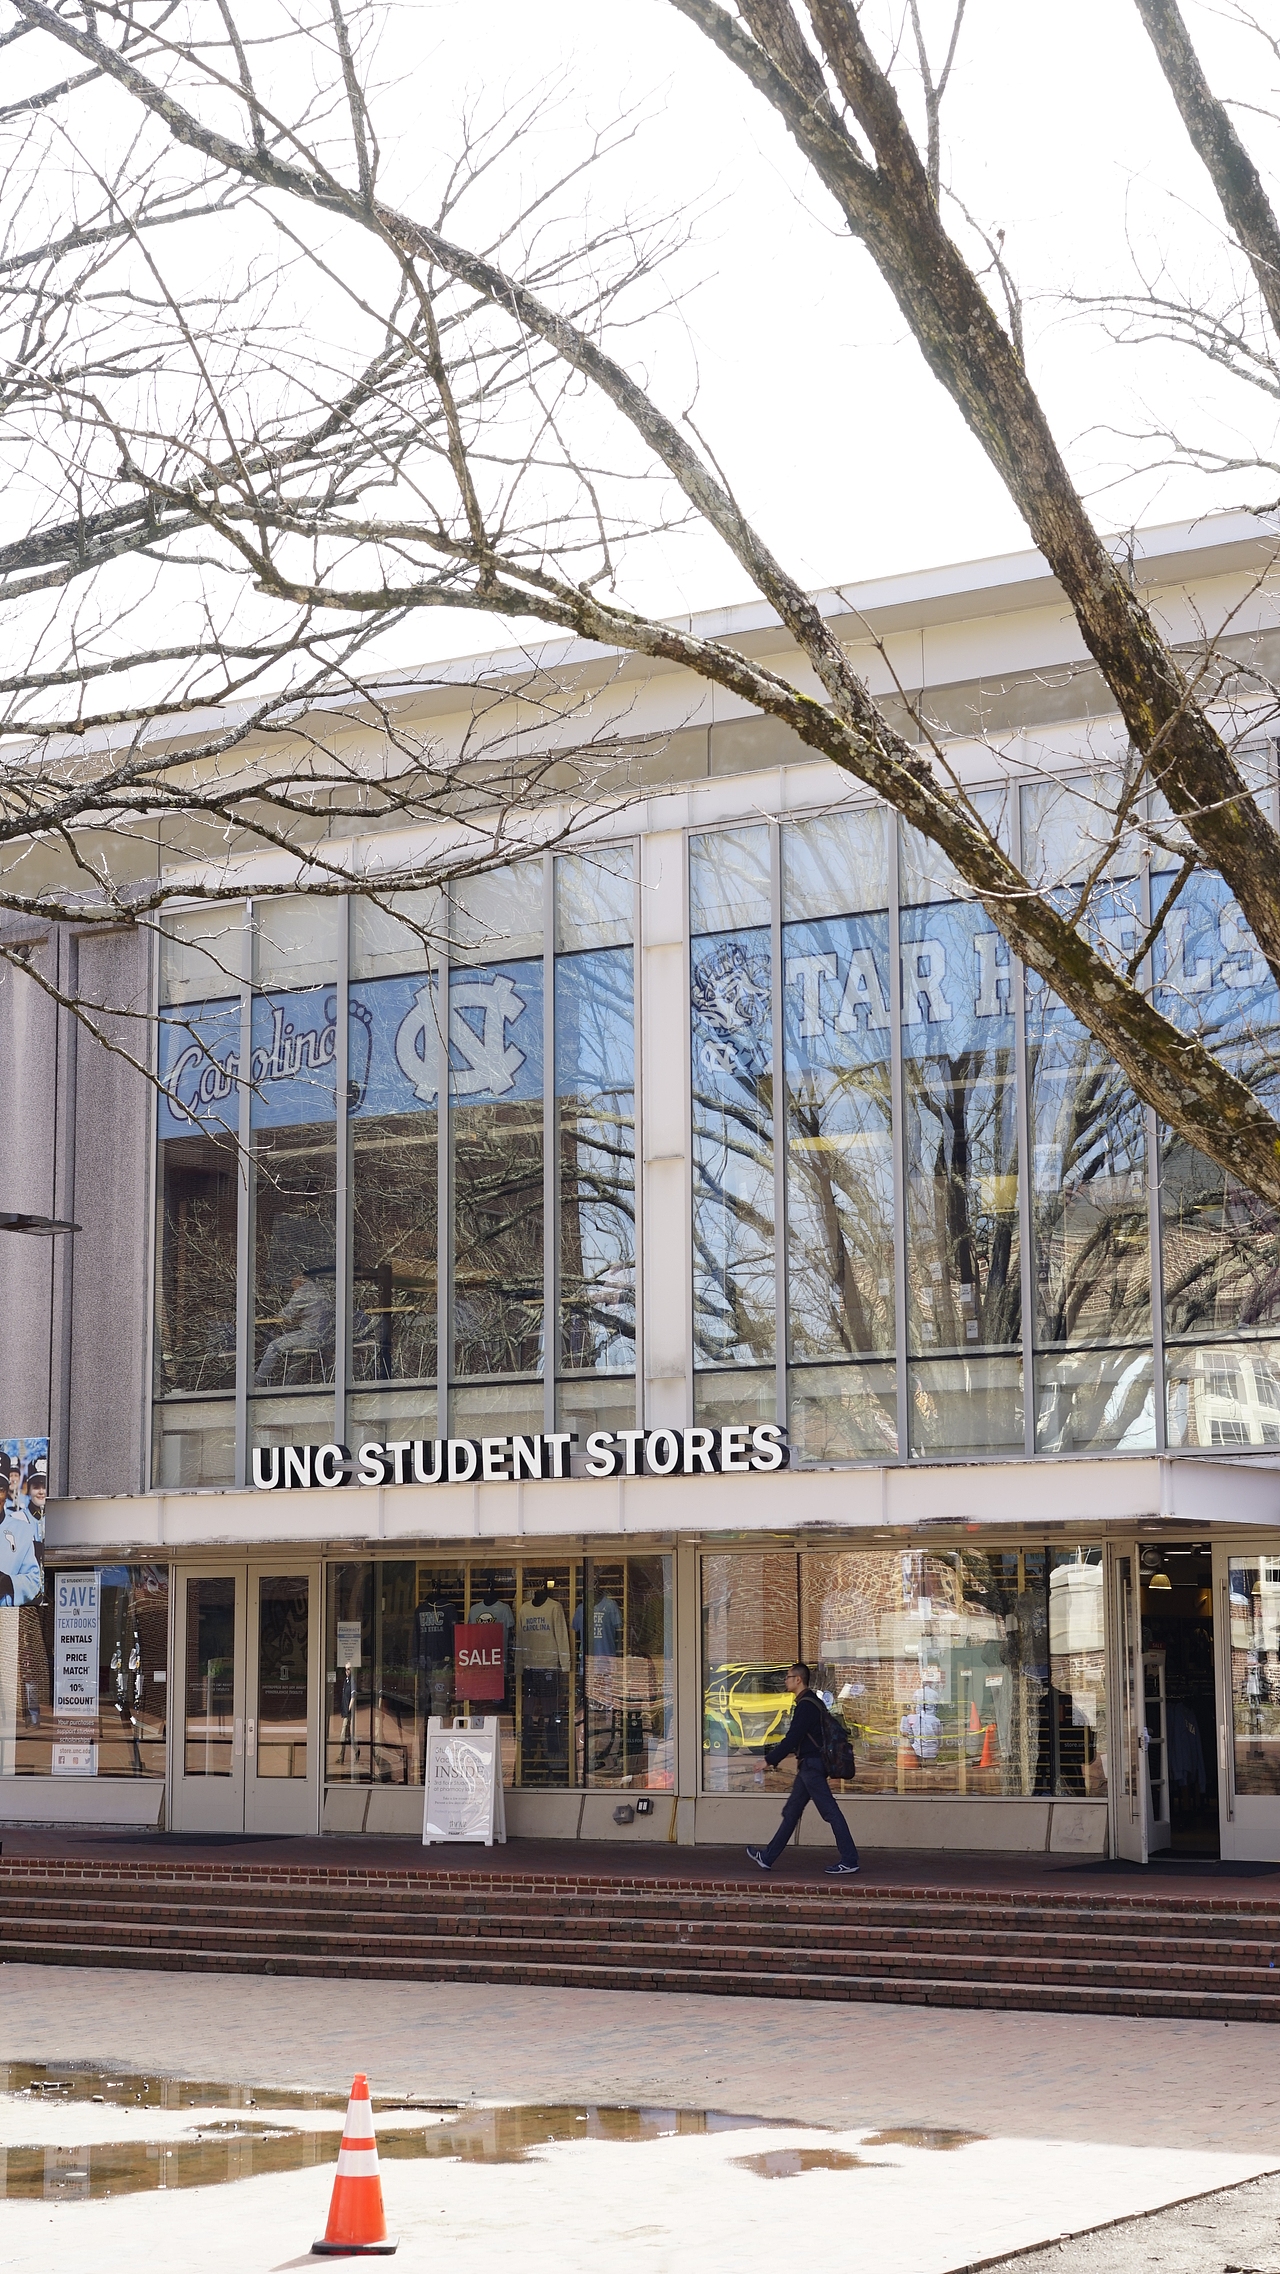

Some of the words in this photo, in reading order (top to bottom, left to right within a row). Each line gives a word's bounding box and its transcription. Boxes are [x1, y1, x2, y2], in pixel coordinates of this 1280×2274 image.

[784, 937, 953, 1039] TAR
[974, 900, 1276, 1018] HELS
[252, 1443, 347, 1490] UNC
[357, 1432, 575, 1486] STUDENT
[585, 1423, 787, 1477] STORES
[59, 1586, 96, 1607] SAVE
[73, 1608, 80, 1616] ON
[58, 1618, 97, 1629] TEXTBOOKS
[419, 1611, 445, 1627] UNC
[526, 1616, 546, 1625] NORTH
[522, 1623, 551, 1633] CAROLINA
[60, 1635, 93, 1644] RENTALS
[65, 1653, 88, 1662] PRICE
[458, 1648, 501, 1667] SALE
[69, 1683, 85, 1692] 10%
[435, 1765, 485, 1778] INSIDE
